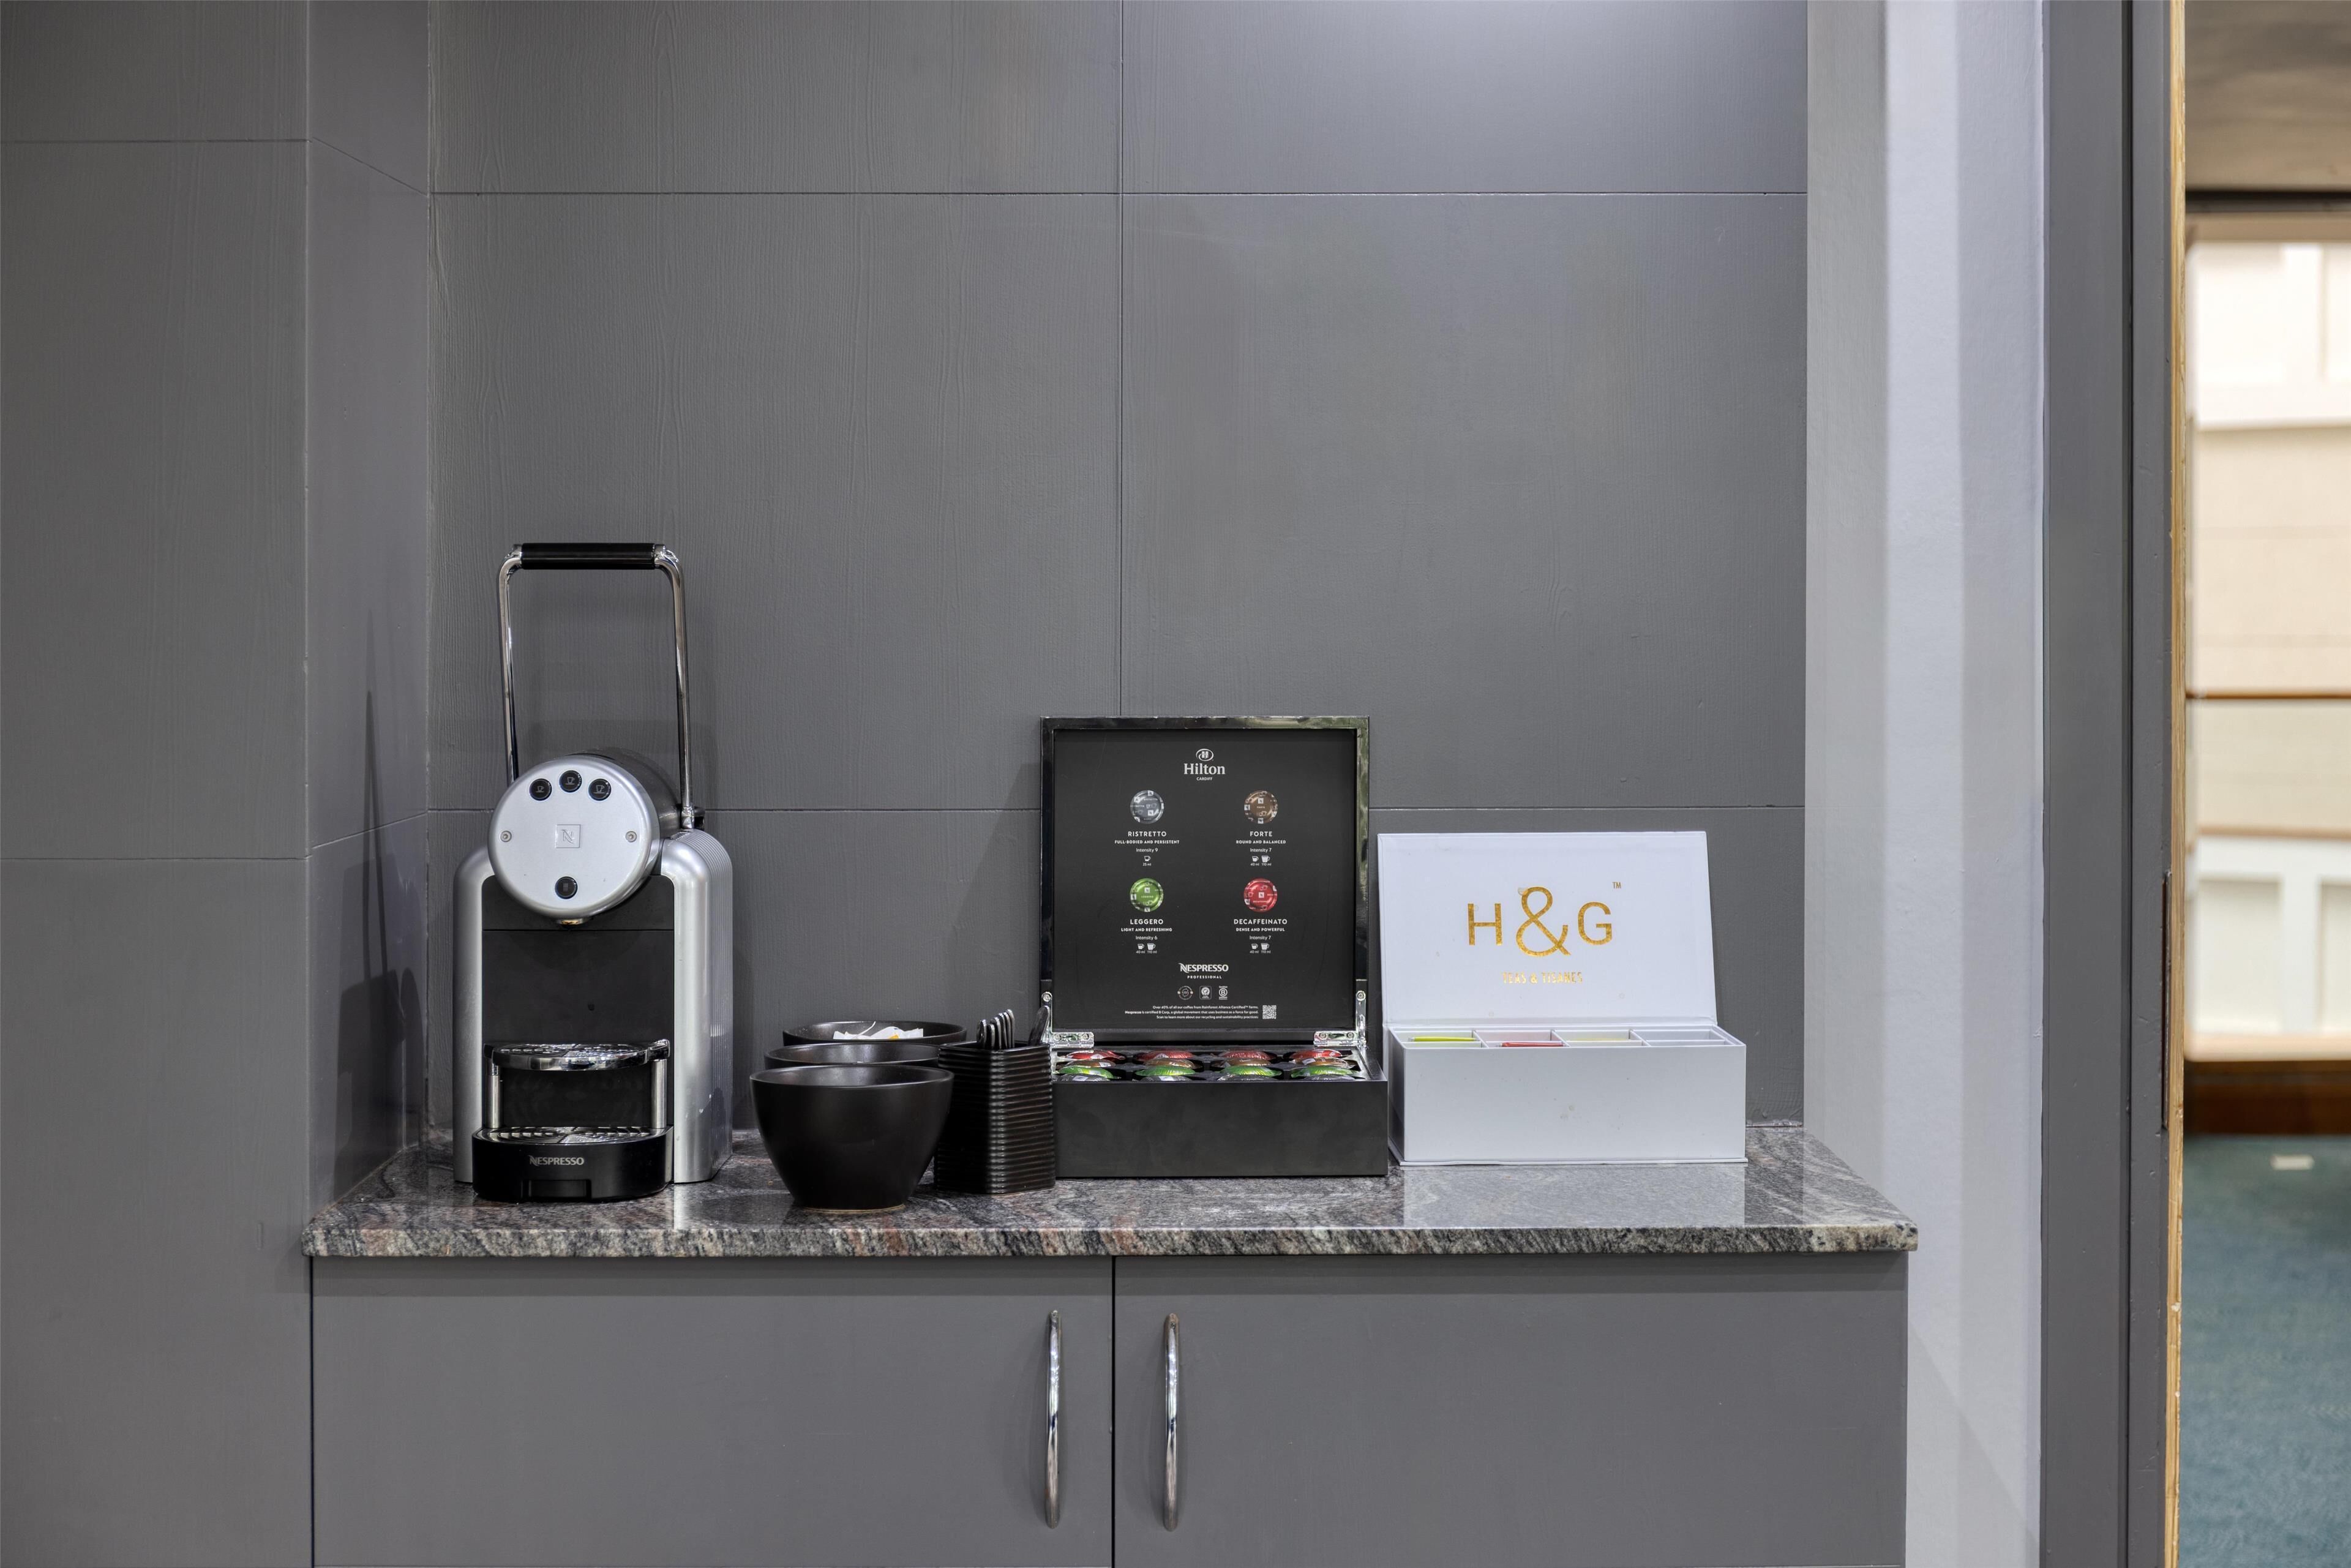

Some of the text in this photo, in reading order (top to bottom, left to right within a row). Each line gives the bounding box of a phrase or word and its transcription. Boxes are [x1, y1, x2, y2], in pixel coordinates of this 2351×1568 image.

[1183, 763, 1226, 775] Hilton
[1178, 962, 1229, 973] NESPRESSO
[1502, 971, 1583, 985] TEAS & TISANES
[528, 1155, 585, 1166] NESPRESSO
